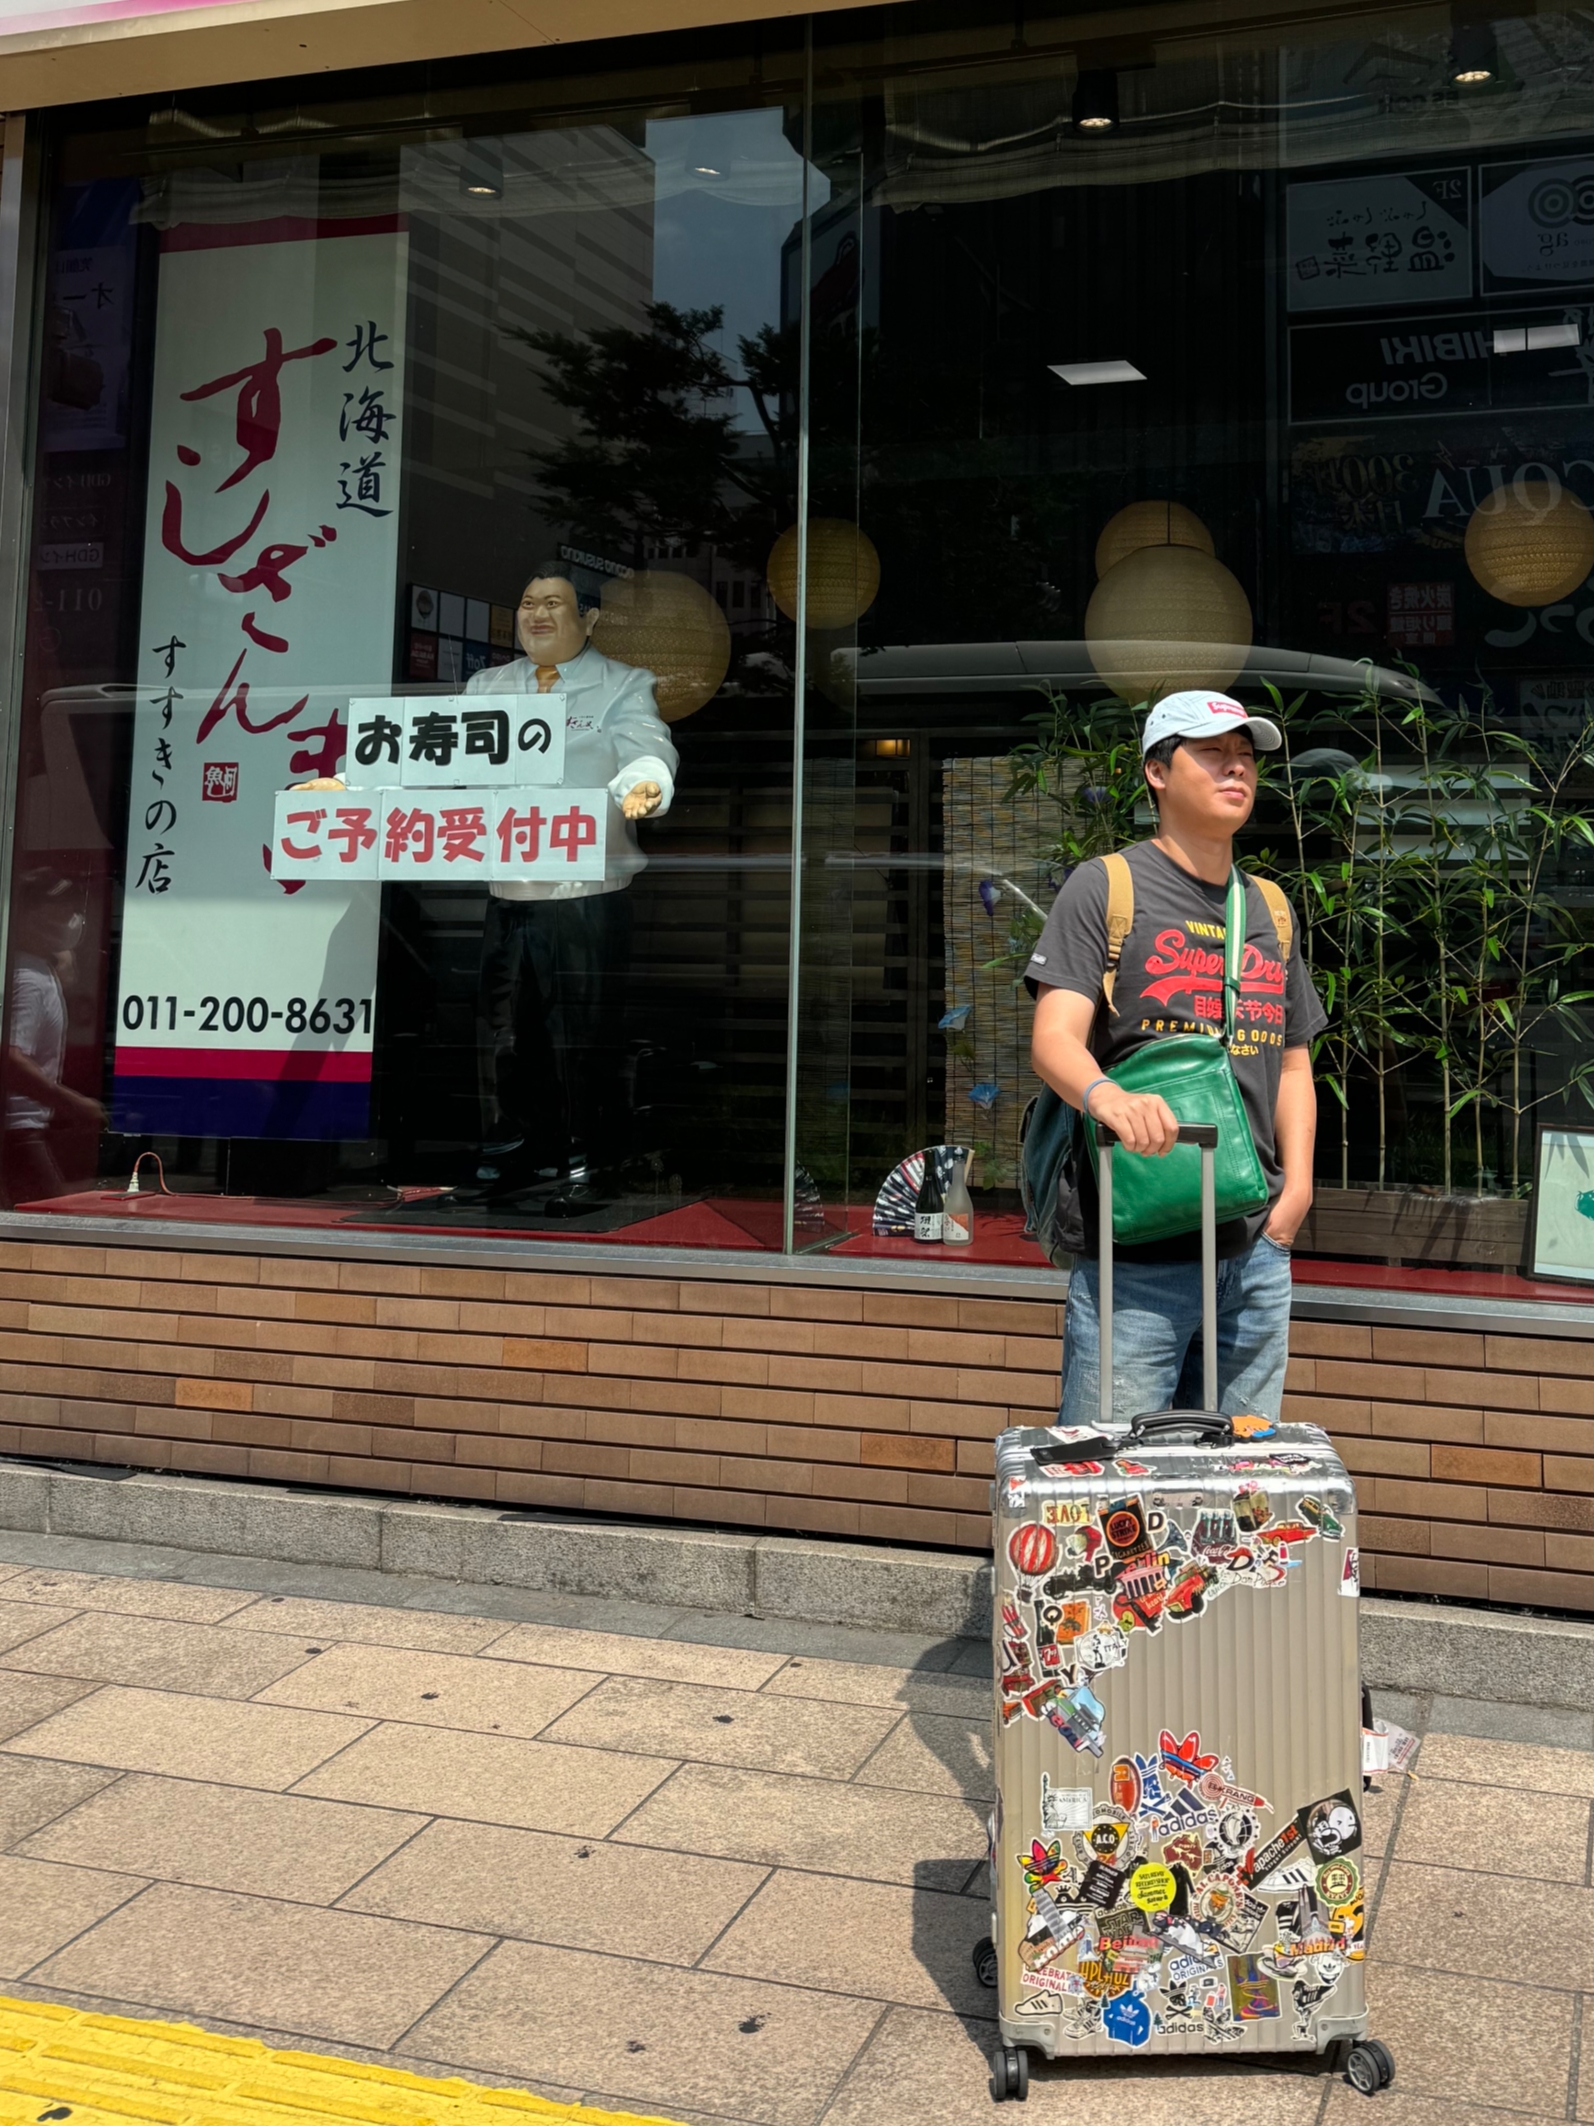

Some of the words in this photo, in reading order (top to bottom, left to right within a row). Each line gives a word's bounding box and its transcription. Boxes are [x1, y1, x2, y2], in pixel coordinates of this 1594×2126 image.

[335, 320, 396, 518] 北海道
[160, 327, 348, 896] すしざんま
[355, 709, 552, 766] お寿司の
[136, 635, 187, 895] すすきの店
[281, 805, 597, 863] ご予約受付中
[1185, 920, 1226, 940] VINTA
[122, 994, 373, 1034] 011-200-8631
[1095, 1555, 1111, 1576] P
[1060, 1664, 1077, 1684] Y
[1093, 1808, 1126, 1820] OMOBILE
[1158, 1807, 1218, 1836] adidas
[1290, 1937, 1346, 1956] Madrid
[1159, 2020, 1204, 2035] adidas
